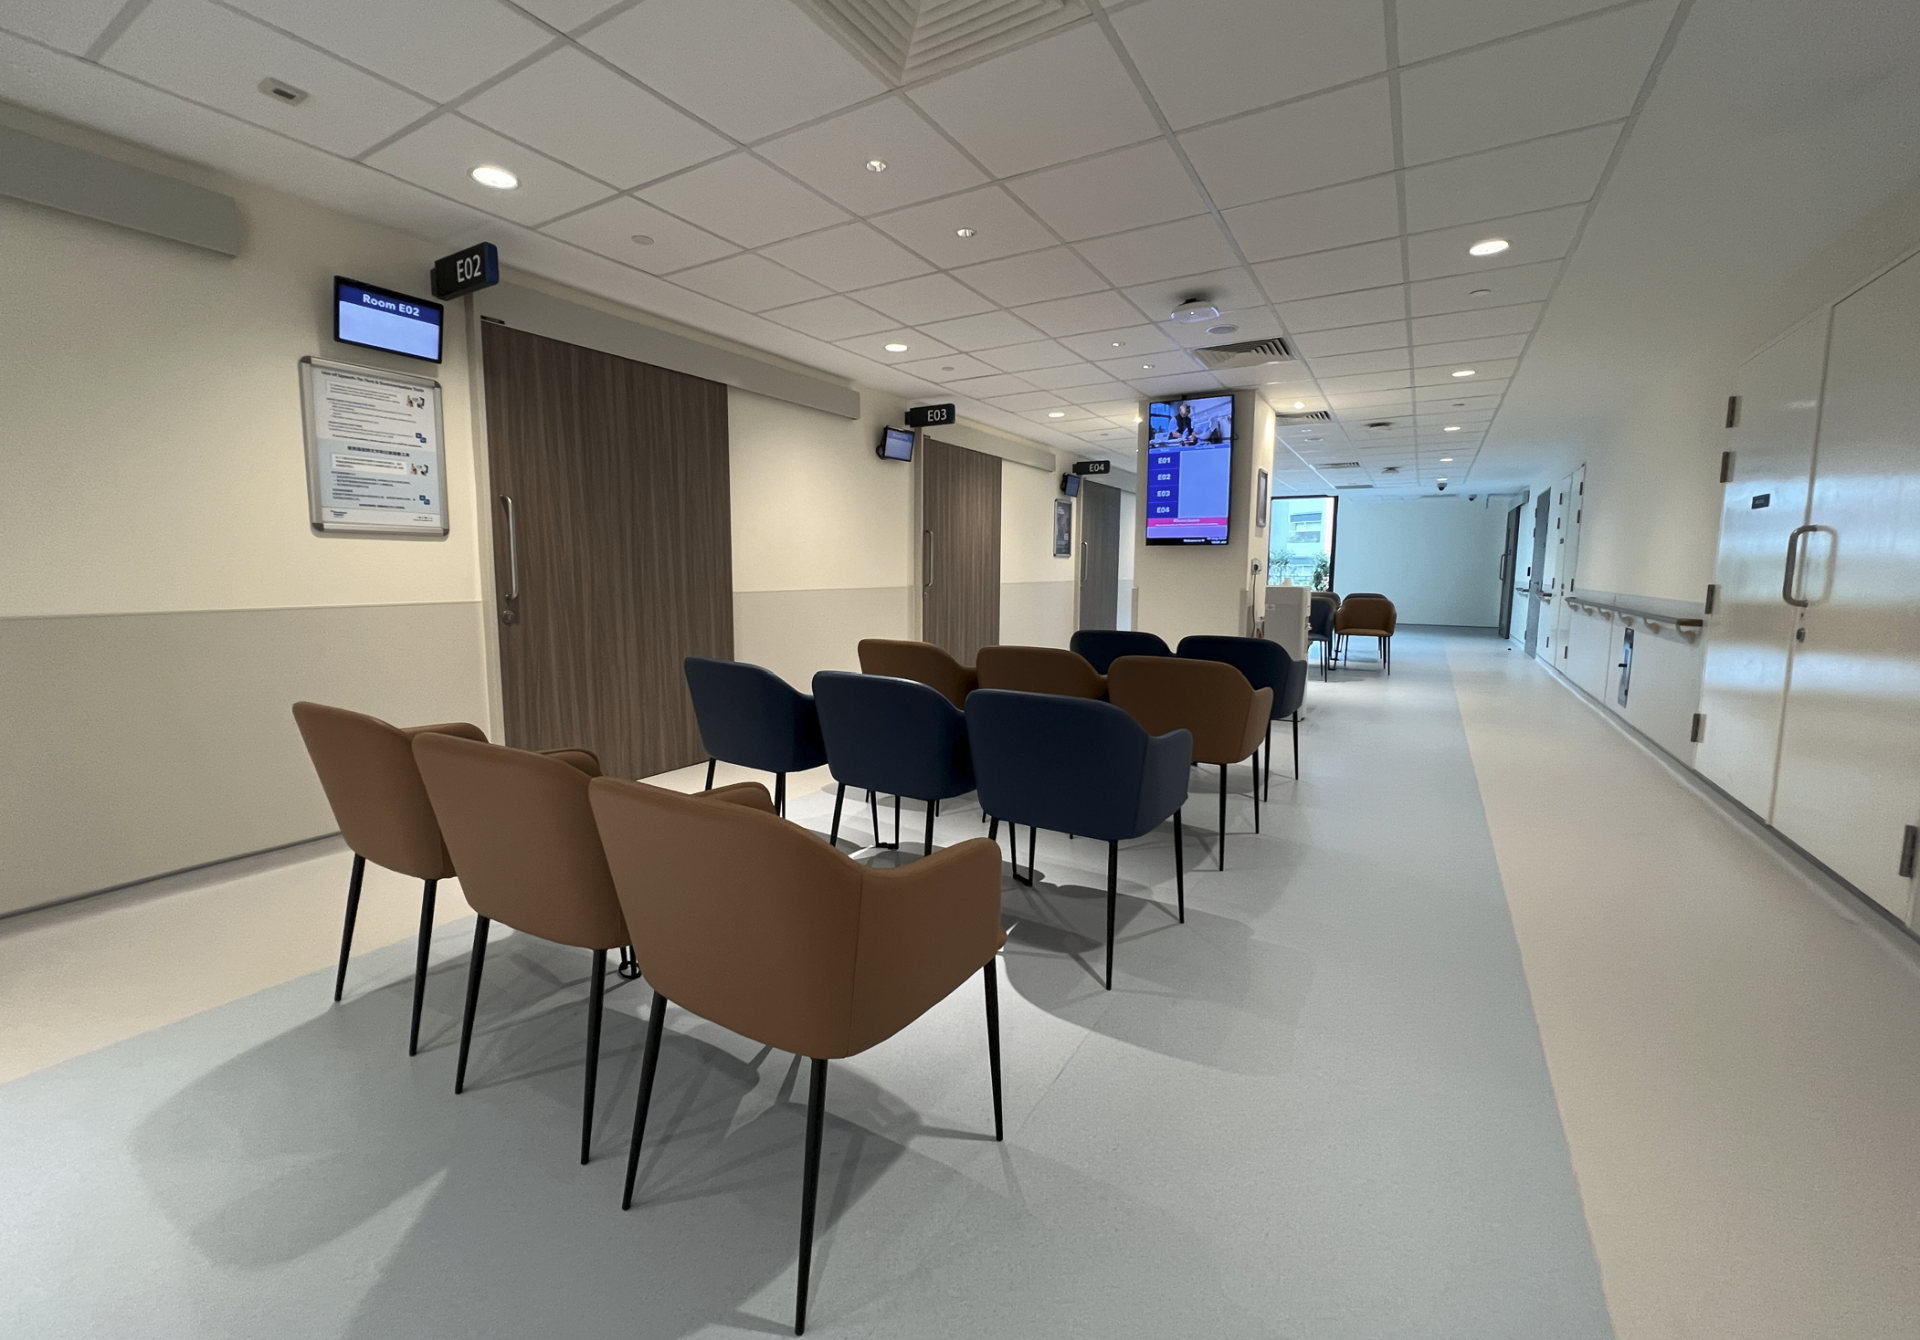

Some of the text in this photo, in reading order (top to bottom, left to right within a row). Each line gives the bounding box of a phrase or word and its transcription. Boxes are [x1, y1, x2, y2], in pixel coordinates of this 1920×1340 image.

[456, 254, 482, 283] E02
[362, 293, 420, 317] Room E02
[927, 408, 947, 422] E03
[1089, 463, 1105, 472] E04
[1157, 473, 1171, 481] E02
